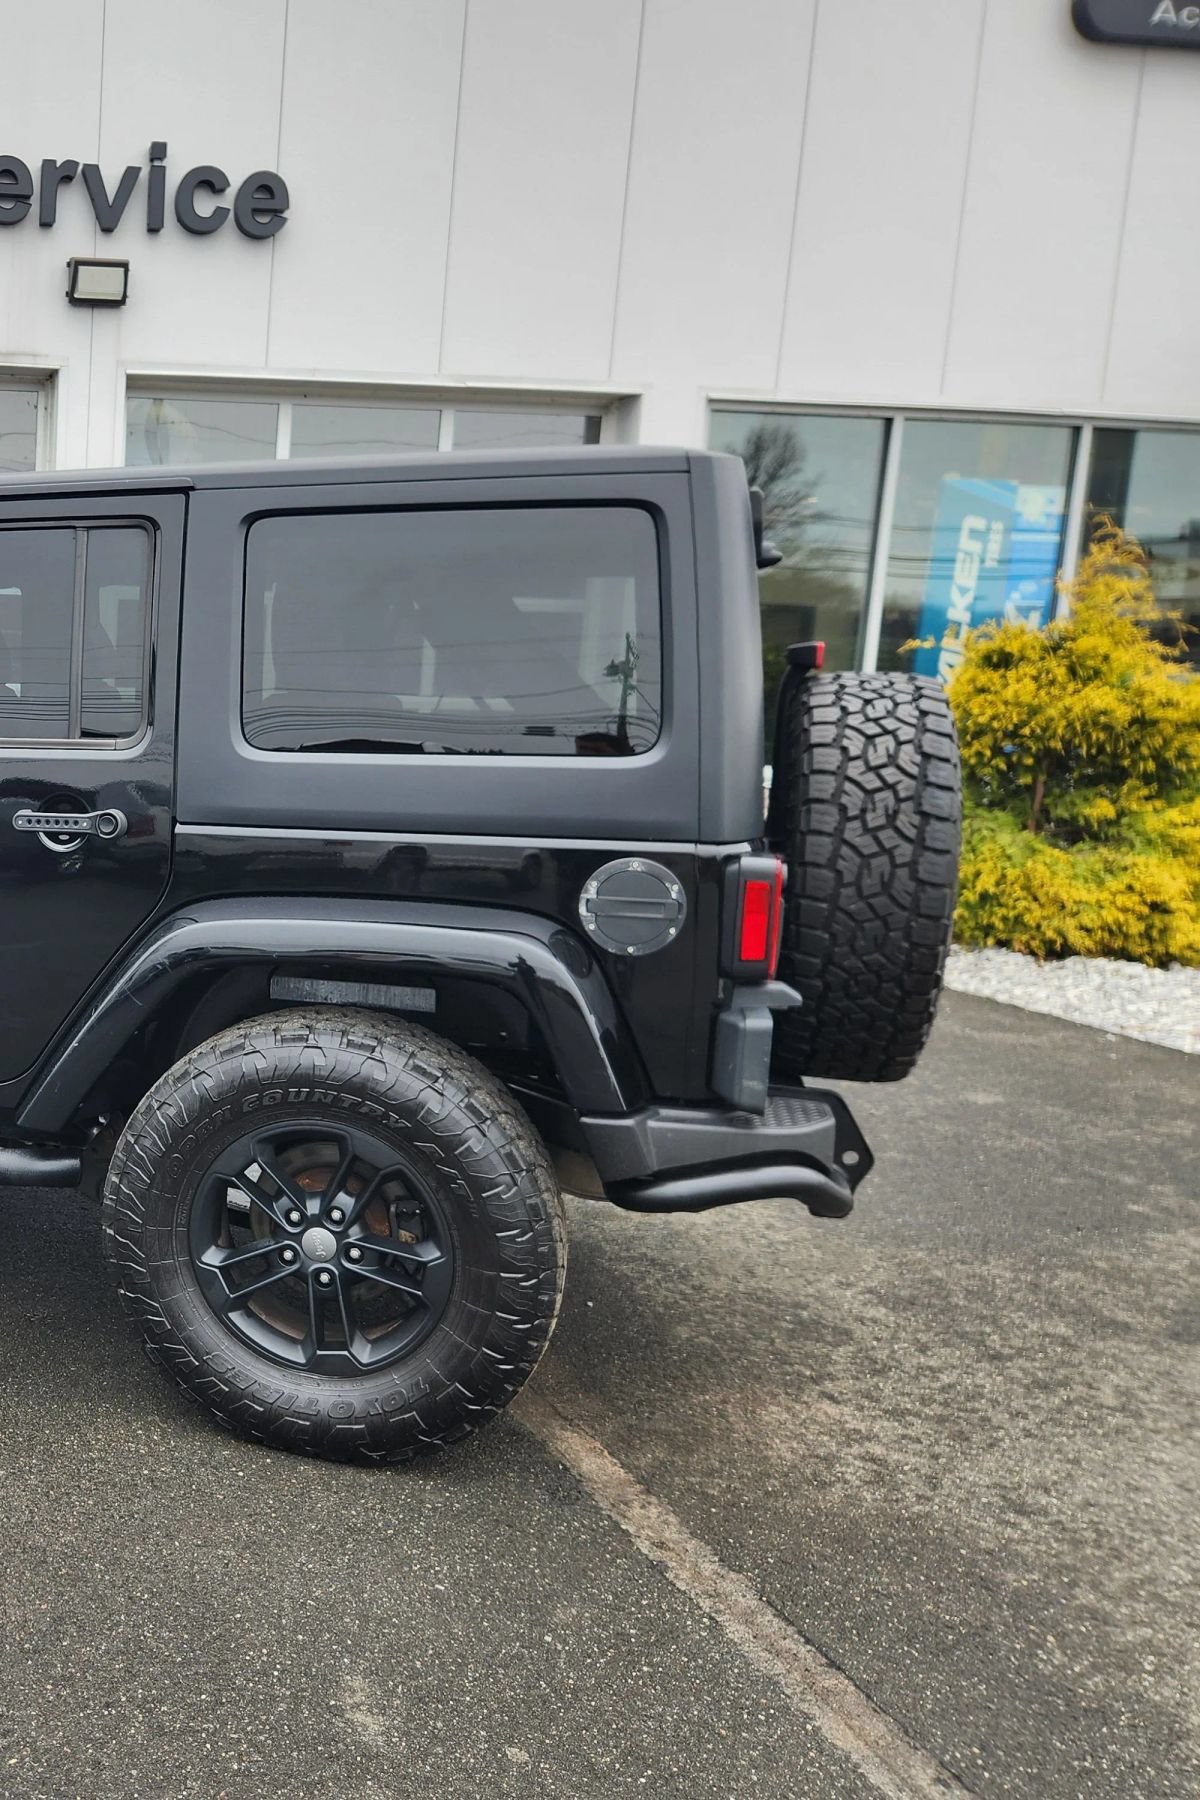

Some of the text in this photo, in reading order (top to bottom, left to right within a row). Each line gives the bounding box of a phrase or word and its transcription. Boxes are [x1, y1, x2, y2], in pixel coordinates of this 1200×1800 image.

[241, 1088, 413, 1129] COUNTRY
[202, 1351, 431, 1419] TOYO TIRES
